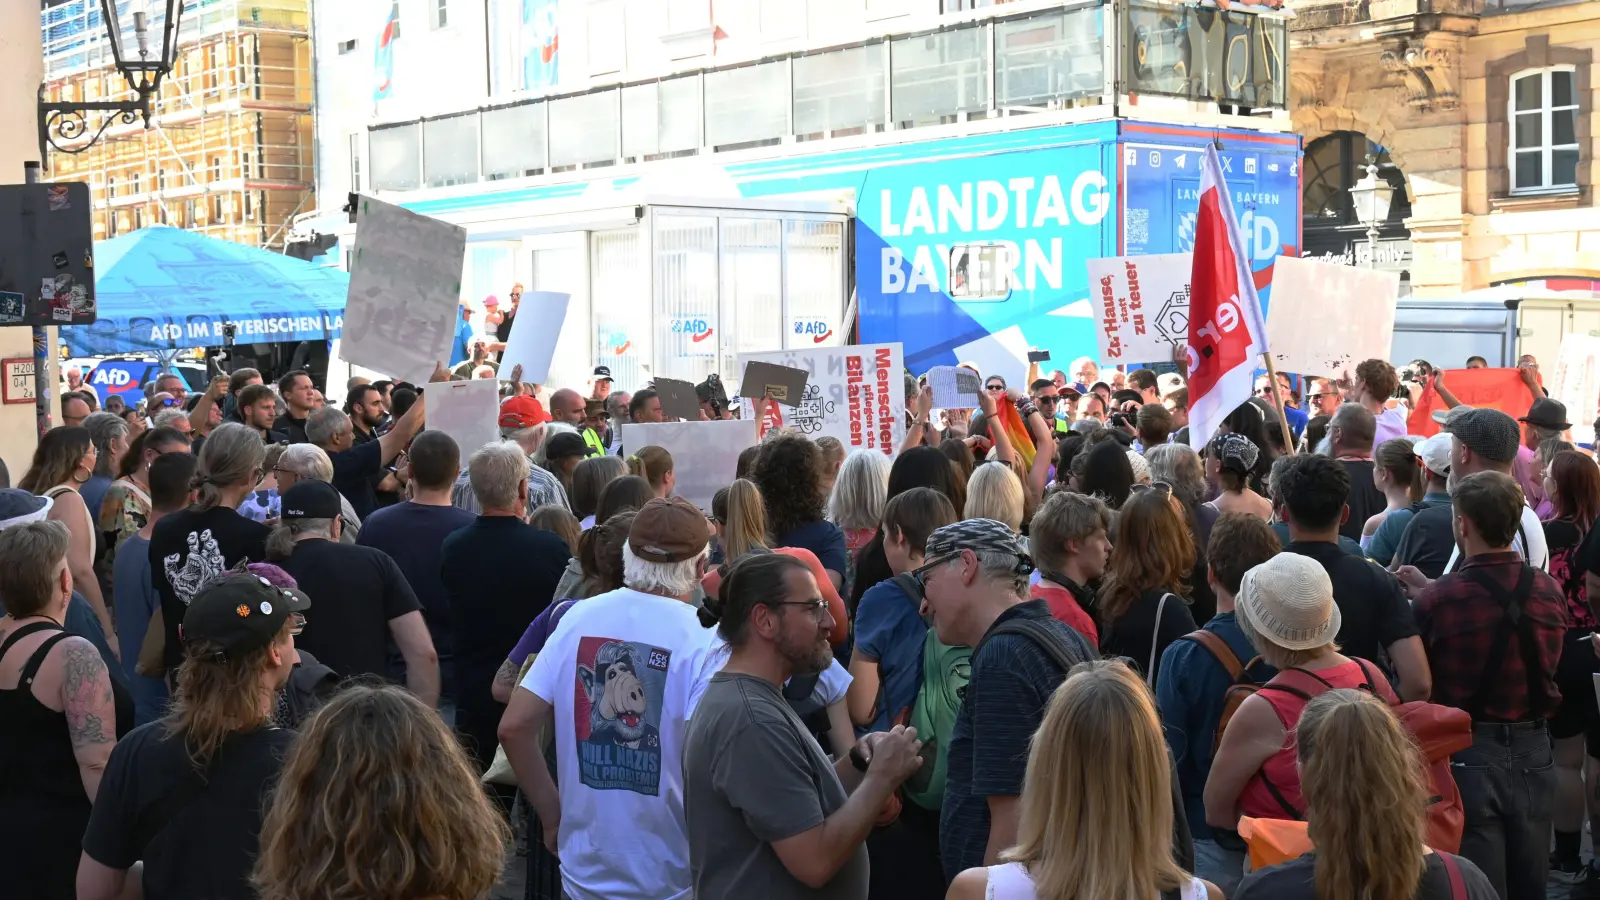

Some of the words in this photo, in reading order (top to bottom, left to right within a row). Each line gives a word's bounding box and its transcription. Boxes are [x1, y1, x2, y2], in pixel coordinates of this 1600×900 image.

[881, 170, 1110, 236] LANDTAG
[1177, 188, 1199, 200] LAN
[1236, 192, 1280, 204] BAYERN
[1240, 210, 1279, 260] fD
[881, 238, 1063, 294] BAYERN
[1125, 261, 1142, 311] teuer
[1118, 297, 1129, 323] statt
[151, 324, 182, 340] AfD
[187, 322, 209, 338] IM
[213, 315, 321, 335] BYERISCHEN
[326, 315, 344, 331] LA
[683, 319, 707, 333] AfD
[805, 321, 827, 335] AfD
[1133, 313, 1146, 335] zu
[94, 368, 130, 386] AfD
[845, 355, 863, 446] Bilanzen
[862, 384, 874, 428] pflegen
[875, 348, 895, 455] Menschen
[867, 431, 876, 449] sta
[648, 658, 666, 668] NZS
[650, 651, 668, 662] FCK
[616, 745, 658, 773] NAZIS
